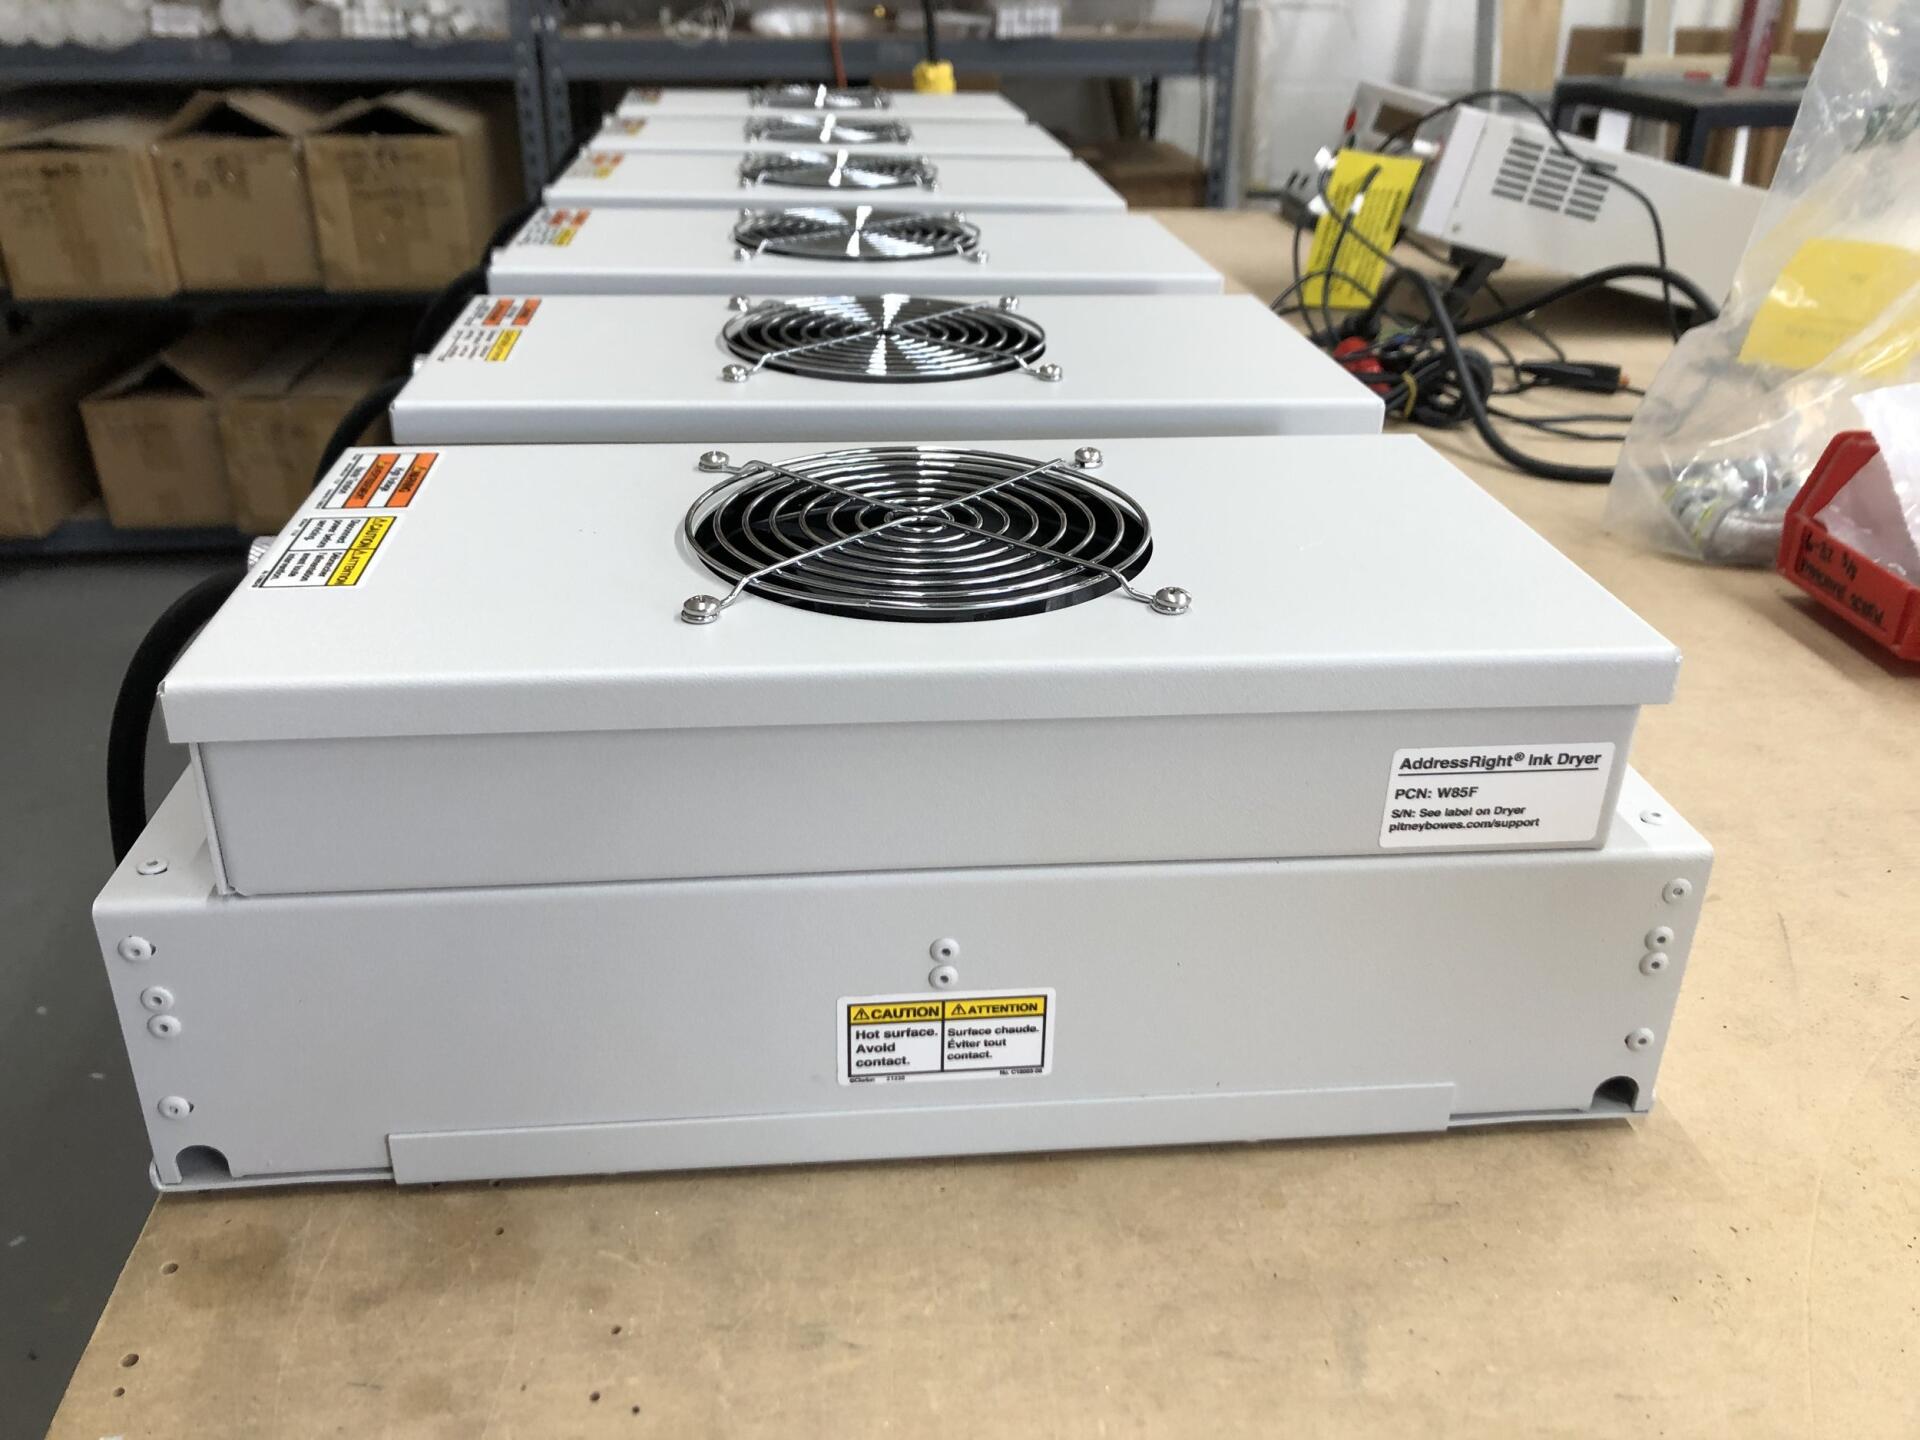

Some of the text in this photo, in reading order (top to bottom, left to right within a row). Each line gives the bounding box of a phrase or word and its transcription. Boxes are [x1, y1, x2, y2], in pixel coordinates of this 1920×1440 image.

[359, 521, 383, 549] CAUTION
[1528, 753, 1553, 766] Ink
[1557, 752, 1602, 768] Dryer
[1395, 786, 1479, 800] PCN: W85F
[1391, 806, 1526, 818] S/N: See label on Dryer
[1389, 818, 1540, 833] pitneybowes.com/support
[871, 1006, 939, 1020] CAUTION
[968, 1003, 1038, 1015] ATTENTION
[855, 1027, 938, 1040] Hot surface.
[947, 1025, 1040, 1037] Surface chaude.
[855, 1042, 896, 1054] Avoid
[947, 1038, 1007, 1049] Éviter tout
[855, 1056, 911, 1067] contact.
[947, 1051, 993, 1061] contact.
